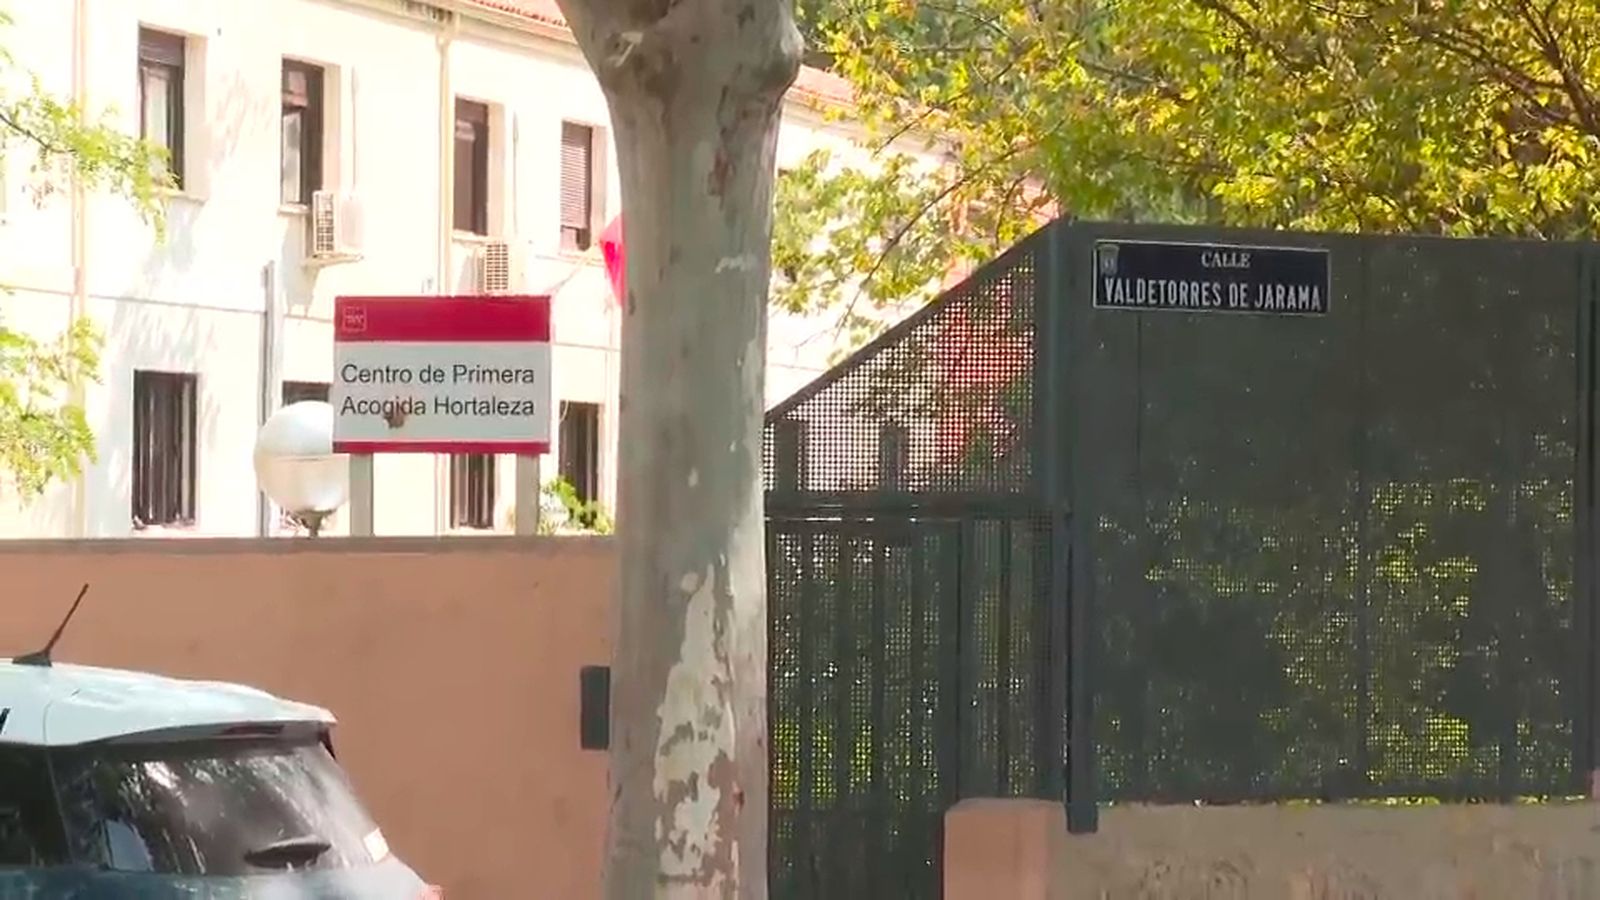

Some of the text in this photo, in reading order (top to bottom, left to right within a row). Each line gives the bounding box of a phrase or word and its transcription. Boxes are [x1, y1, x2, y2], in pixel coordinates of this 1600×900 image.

[1201, 252, 1251, 269] CALLE
[1104, 278, 1321, 312] VALDETORRES DE JARAMA
[340, 363, 535, 384] Centro de Primera
[340, 396, 535, 421] Acogida Hortaleza
